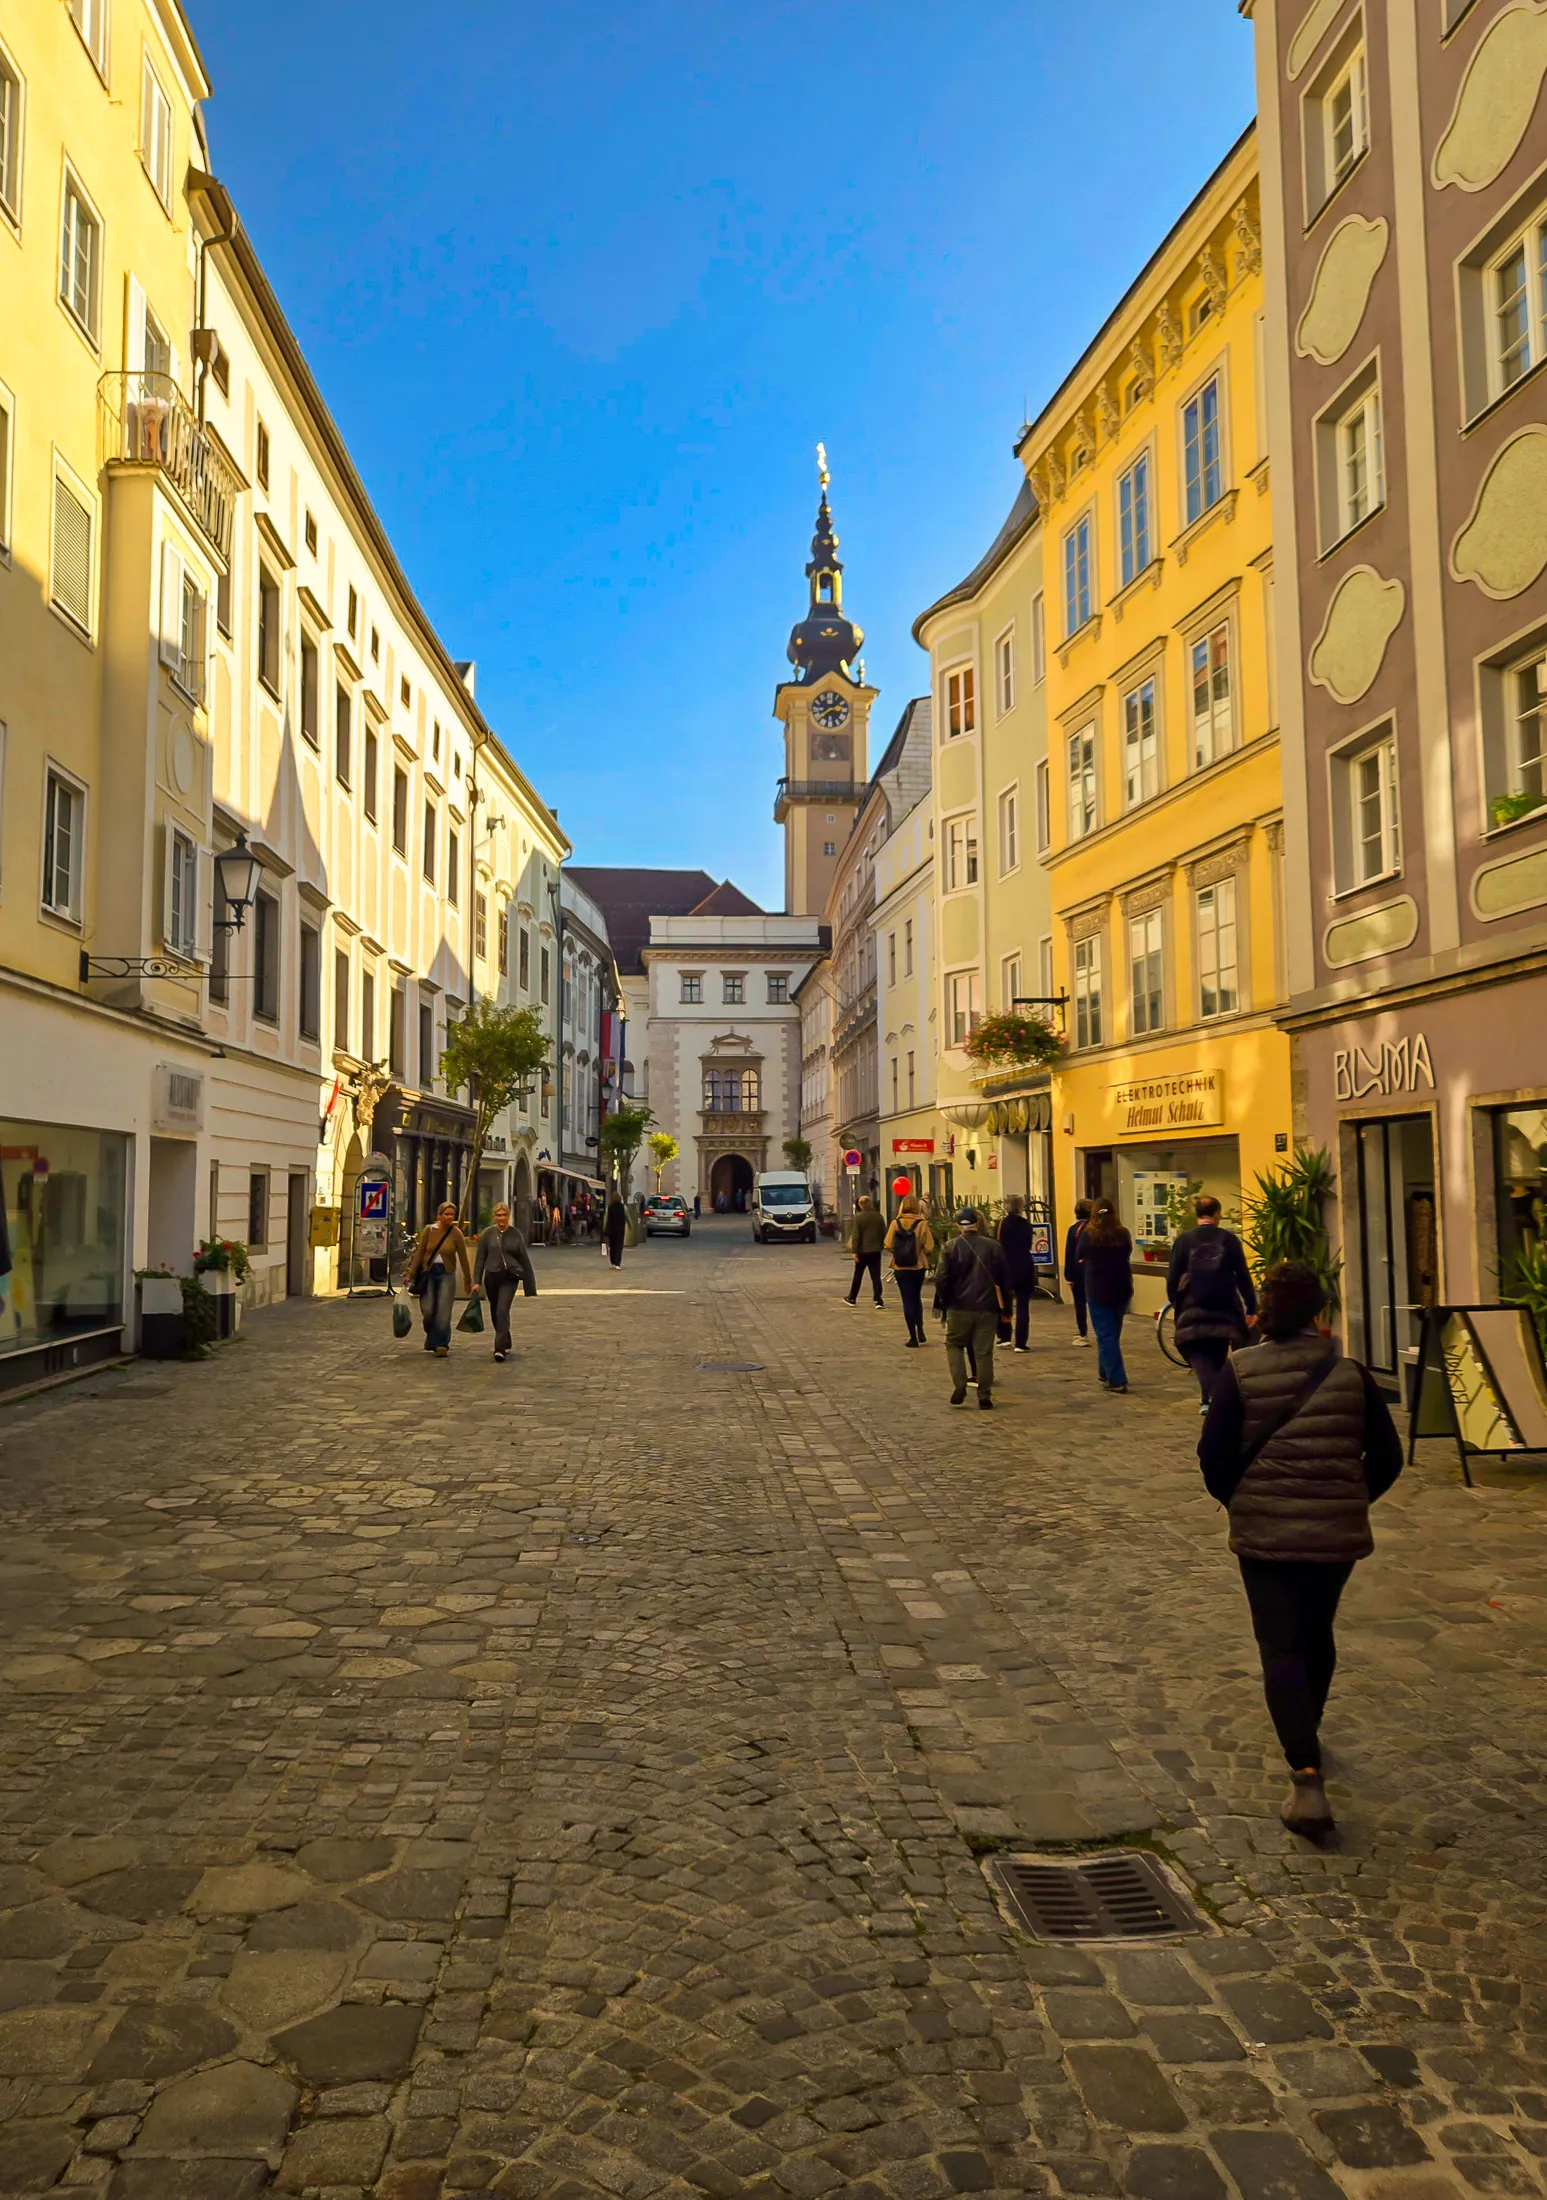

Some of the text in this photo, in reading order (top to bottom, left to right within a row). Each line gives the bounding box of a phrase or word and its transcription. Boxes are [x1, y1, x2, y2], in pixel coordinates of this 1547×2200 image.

[1334, 1033, 1435, 1100] BLUMA
[1117, 1076, 1216, 1103] ELEKTROTECHNIK
[1127, 1105, 1164, 1128] Helmut
